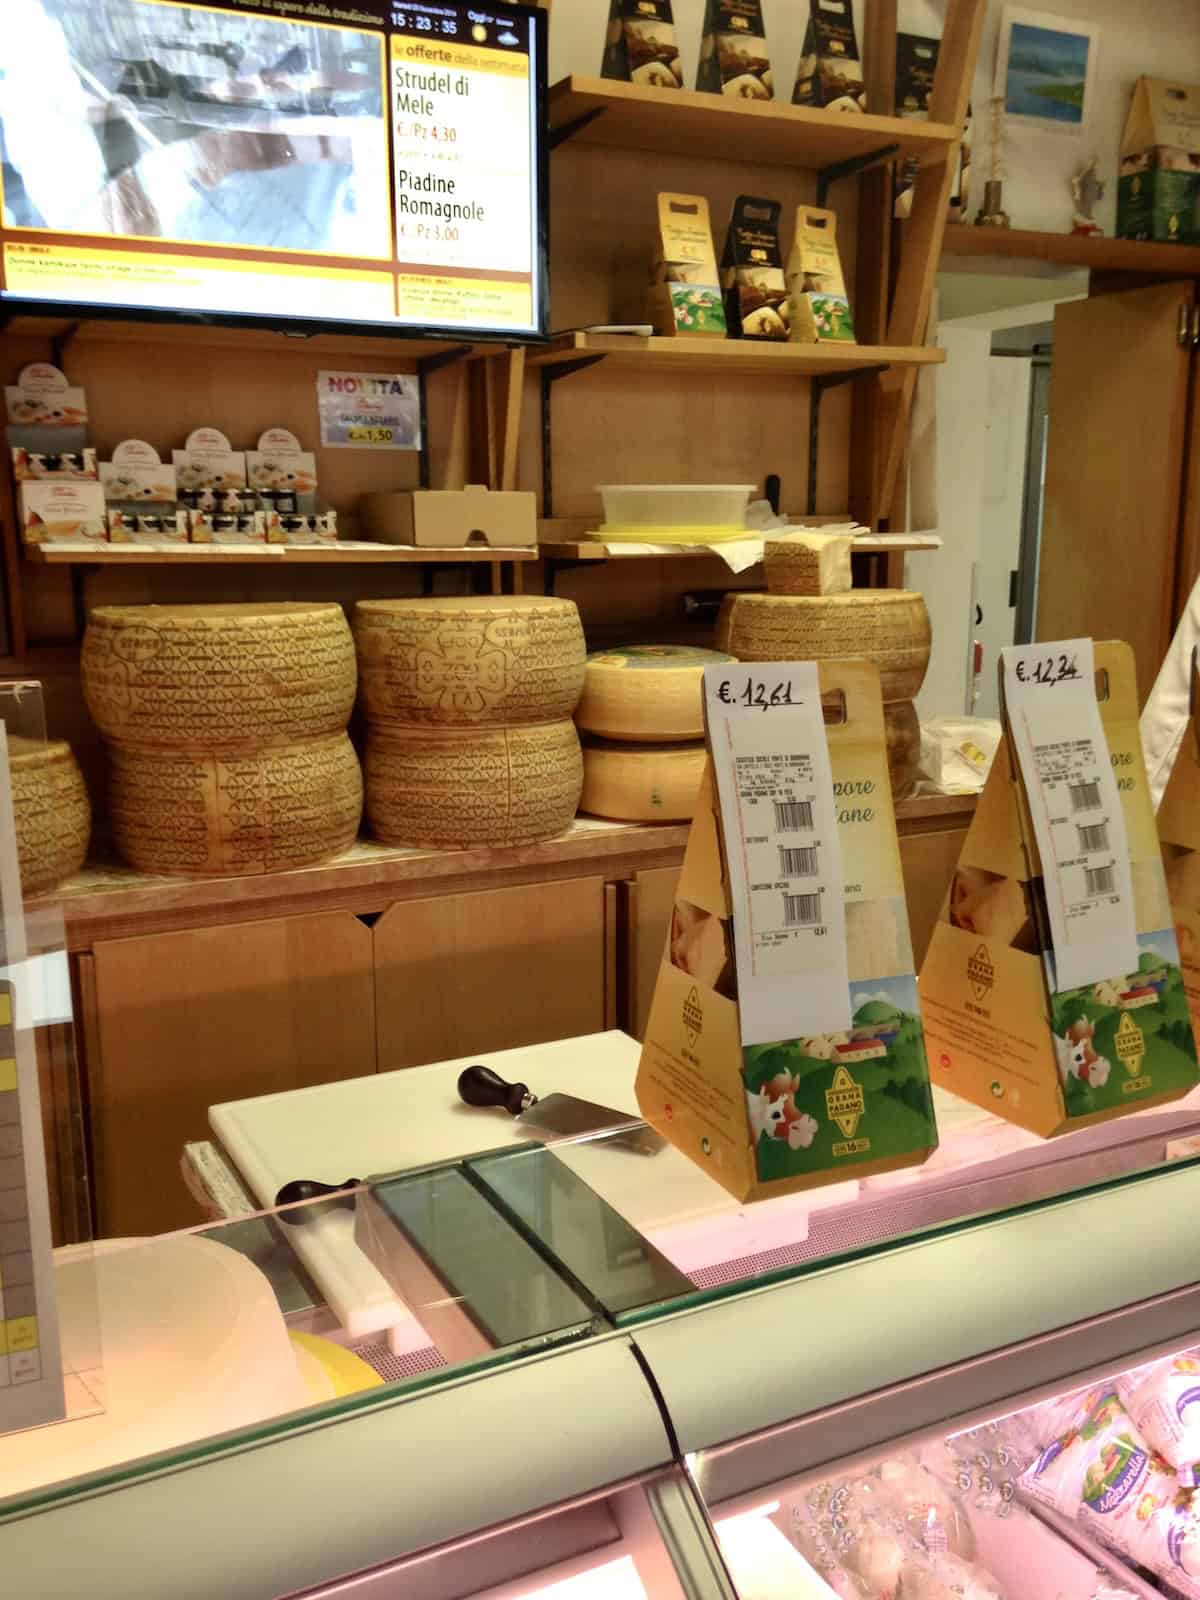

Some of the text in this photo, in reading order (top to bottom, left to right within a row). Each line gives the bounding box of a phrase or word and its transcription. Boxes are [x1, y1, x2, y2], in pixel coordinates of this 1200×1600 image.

[406, 44, 453, 63] offerte
[395, 66, 469, 97] Strudel di
[396, 92, 434, 116] Mele
[399, 169, 456, 194] Piadine
[399, 193, 485, 223] Romagnole
[740, 677, 795, 712] 12,61
